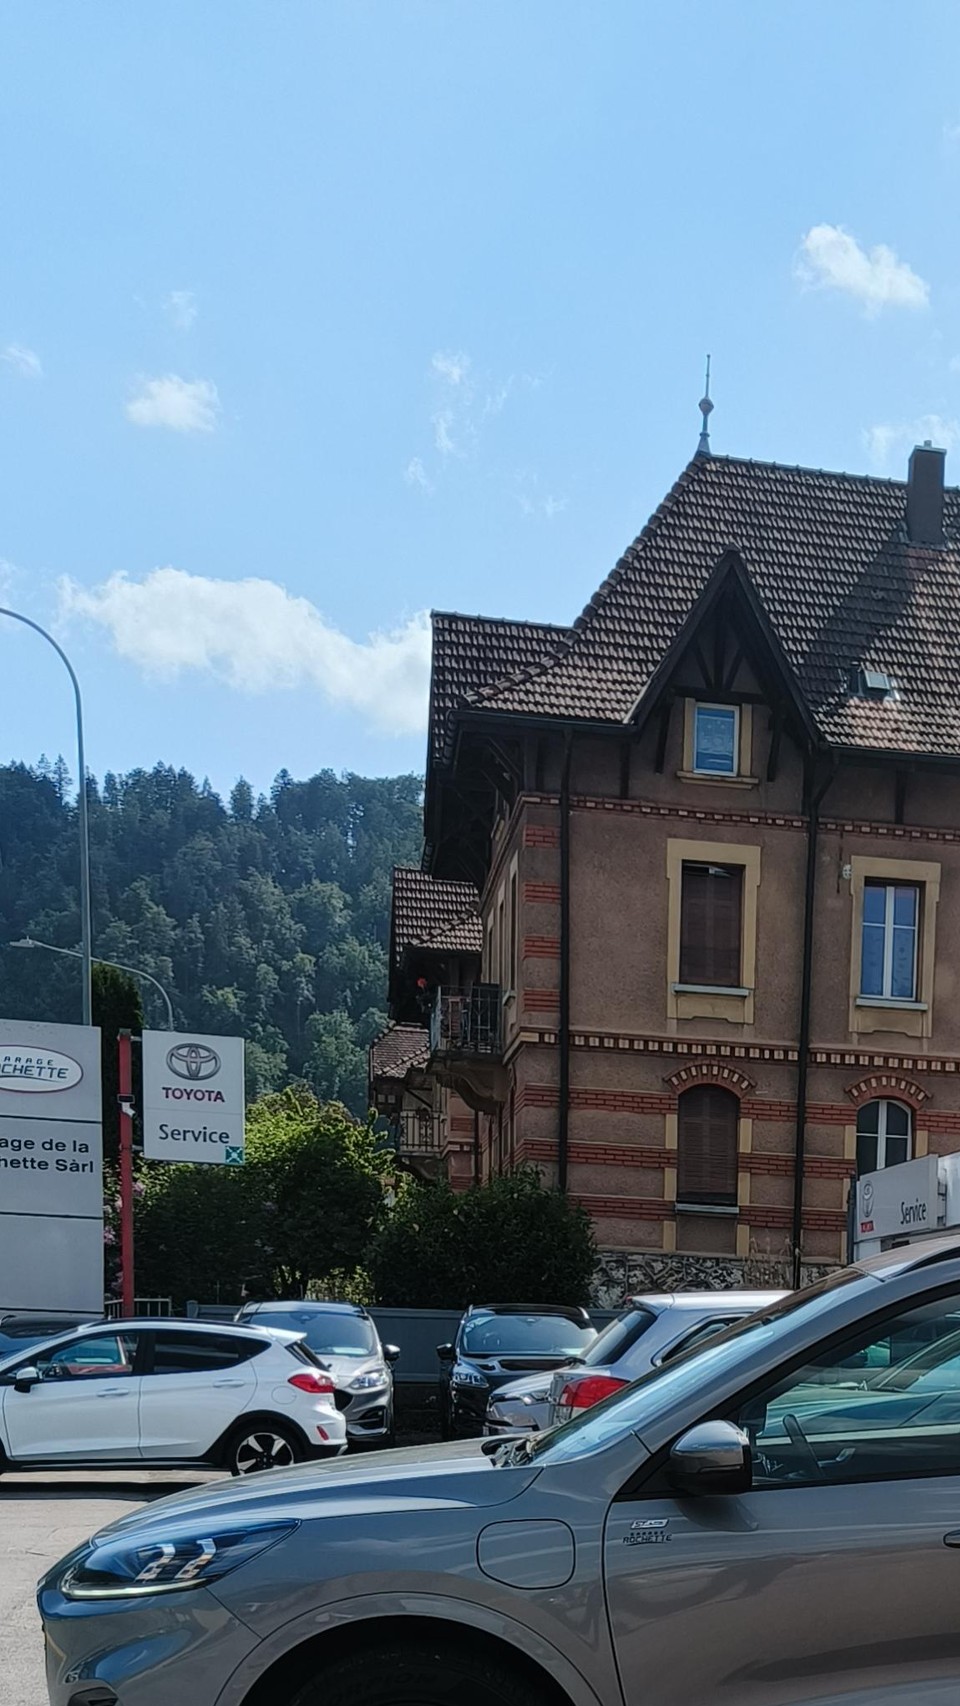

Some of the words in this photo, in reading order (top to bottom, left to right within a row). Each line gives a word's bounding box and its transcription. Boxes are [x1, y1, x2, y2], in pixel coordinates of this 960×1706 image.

[0, 1063, 69, 1079] CHETTE
[162, 1086, 226, 1103] TOYOTA
[159, 1123, 230, 1144] Service
[41, 1138, 66, 1152] de
[73, 1140, 89, 1153] la
[901, 1197, 927, 1225] Service
